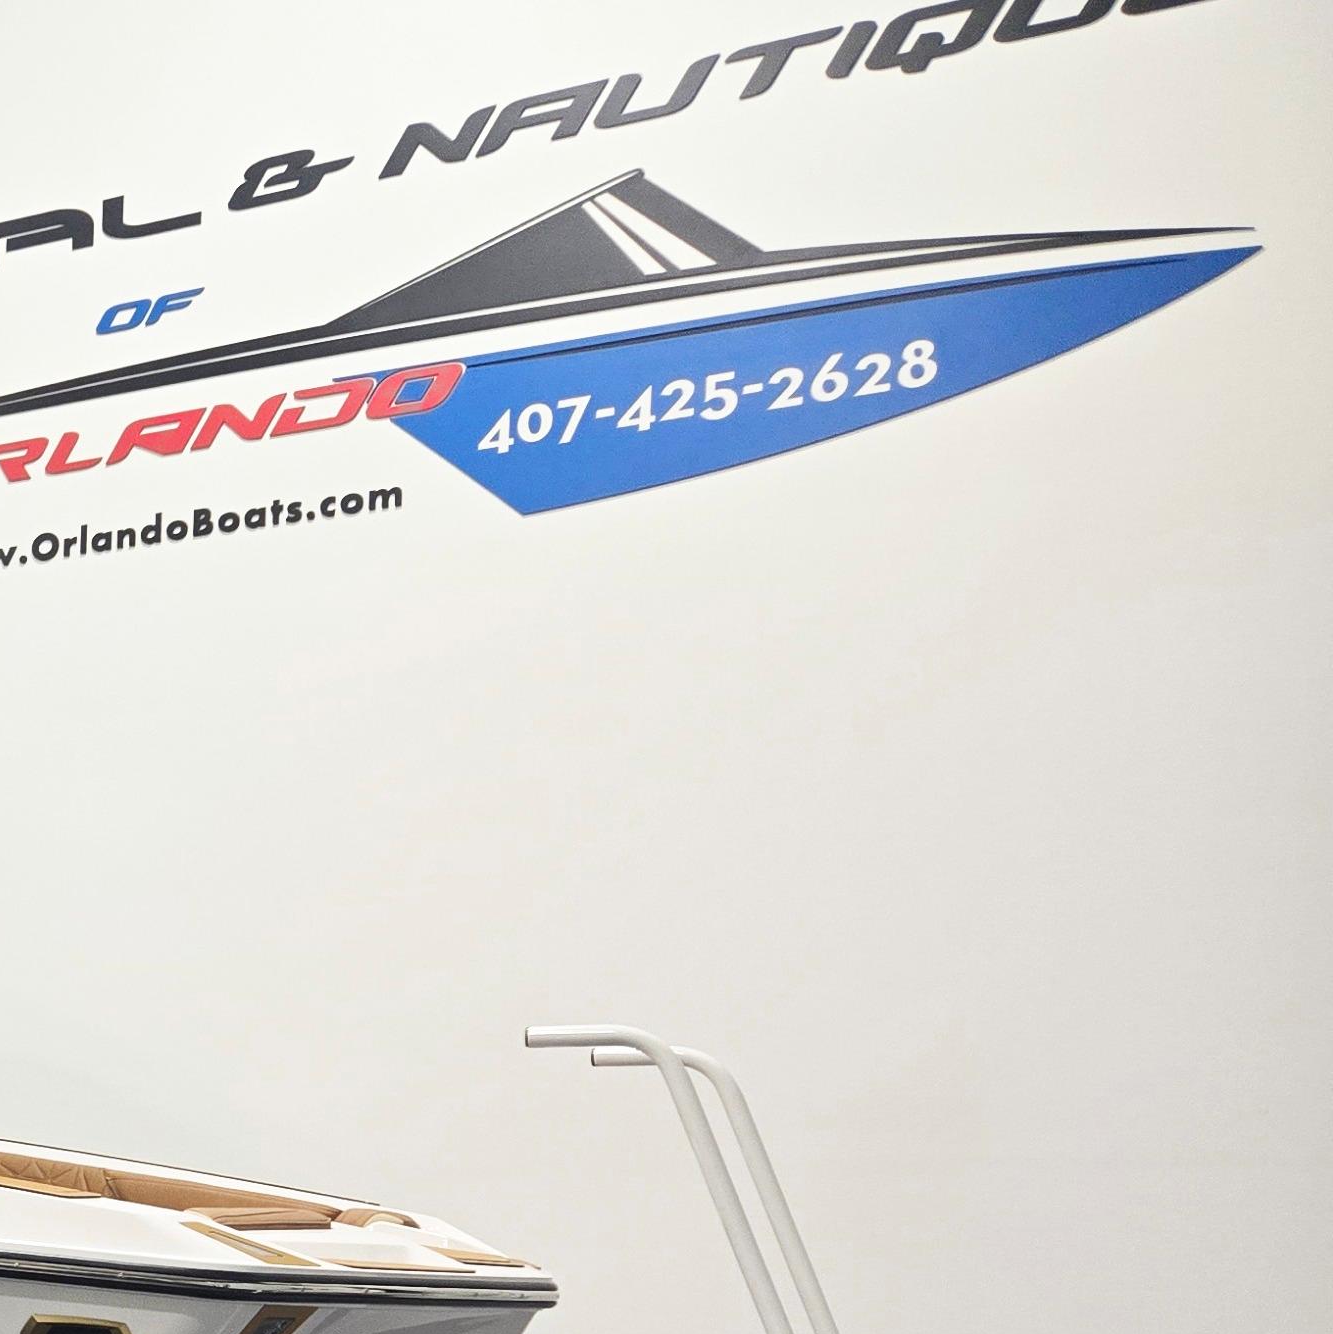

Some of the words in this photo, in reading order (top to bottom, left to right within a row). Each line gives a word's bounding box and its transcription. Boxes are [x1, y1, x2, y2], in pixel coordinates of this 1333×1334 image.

[227, 149, 355, 211] &
[378, 0, 1217, 180] NAUTIQU
[95, 286, 204, 336] OF
[477, 338, 939, 455] 407-425-2628
